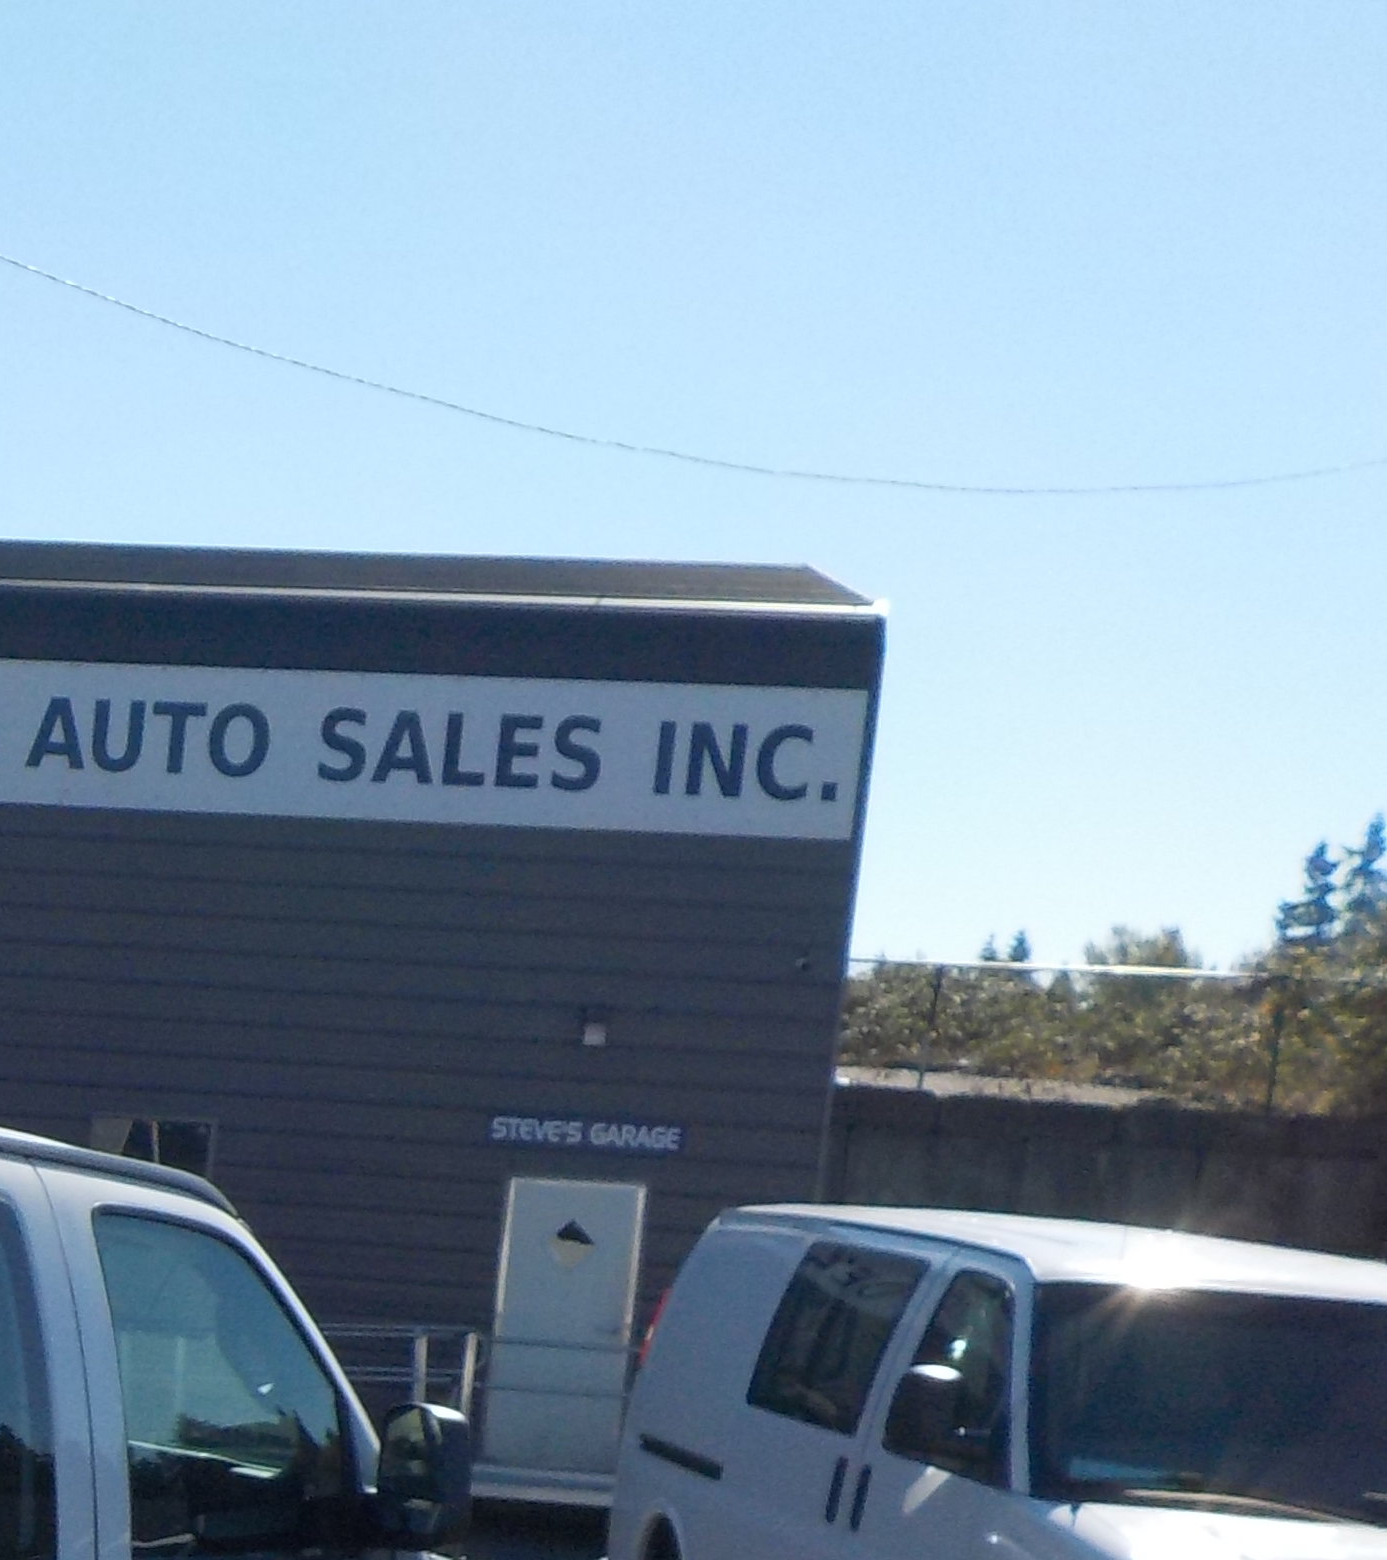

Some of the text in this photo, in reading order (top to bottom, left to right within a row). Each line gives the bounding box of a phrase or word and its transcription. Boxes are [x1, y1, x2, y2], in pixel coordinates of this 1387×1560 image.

[26, 695, 271, 778] AUTO
[317, 706, 603, 792] SALES
[653, 720, 839, 802] INC.
[490, 1116, 682, 1151] STEVE'S GARAGE
